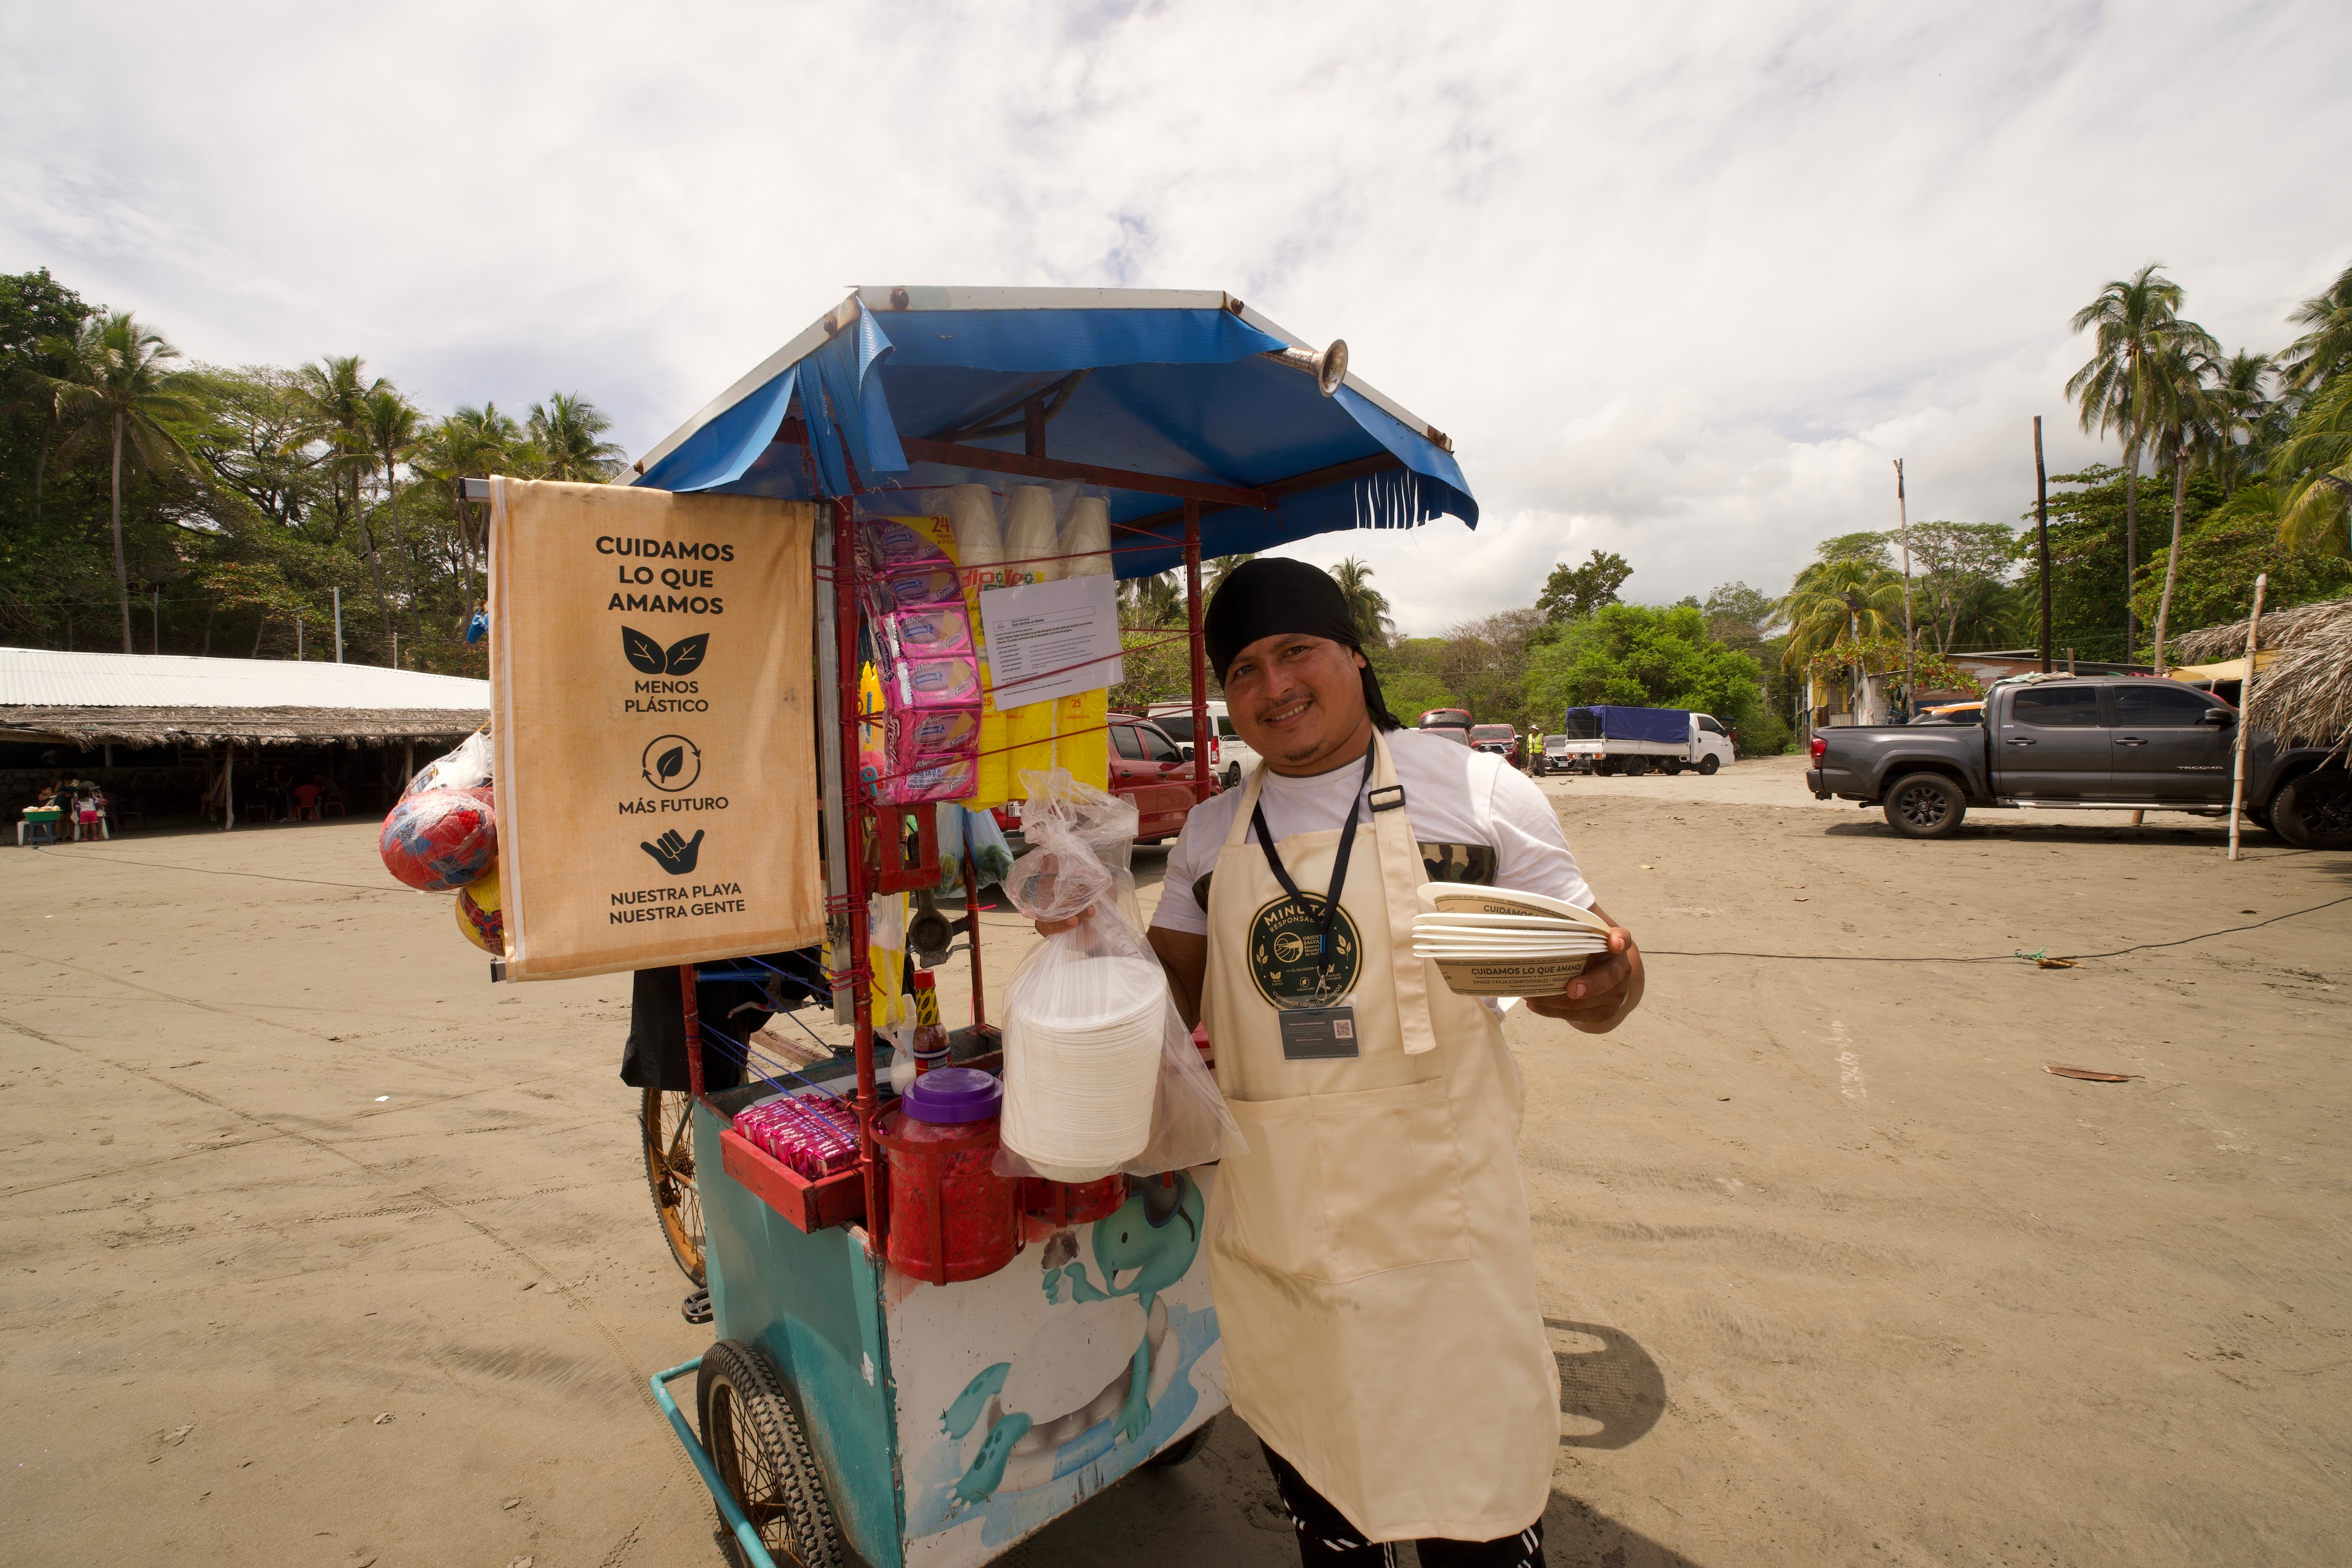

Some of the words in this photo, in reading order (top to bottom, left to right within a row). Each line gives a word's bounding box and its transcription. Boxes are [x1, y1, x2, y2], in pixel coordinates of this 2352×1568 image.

[931, 517, 950, 532] 24
[596, 536, 734, 562] CUIDAMOS
[620, 565, 654, 584] LO
[661, 568, 713, 590] QUE
[937, 587, 951, 598] Fresa
[608, 594, 723, 614] AMAMOS
[906, 616, 925, 624] Wafer
[905, 627, 926, 636] Colombina
[946, 636, 960, 647] Fresa
[876, 633, 889, 671] Colombina
[914, 663, 935, 672] Wafer
[635, 680, 699, 694] MENOS
[955, 684, 970, 695] Fresa
[625, 696, 709, 713] PLÁSTICO
[1072, 699, 1080, 707] 25
[951, 736, 967, 746] Fresa
[619, 797, 657, 815] MÁS
[661, 796, 729, 812] FUTURO
[611, 888, 688, 906] NUESTRA
[693, 883, 742, 897] PLAYA
[610, 906, 687, 924] NUESTRA
[692, 900, 745, 916] GENTE
[1269, 916, 1325, 933] RESPONSAB
[1556, 963, 1582, 972] AMAMOS
[1273, 991, 1298, 1006] CUIDAMOS
